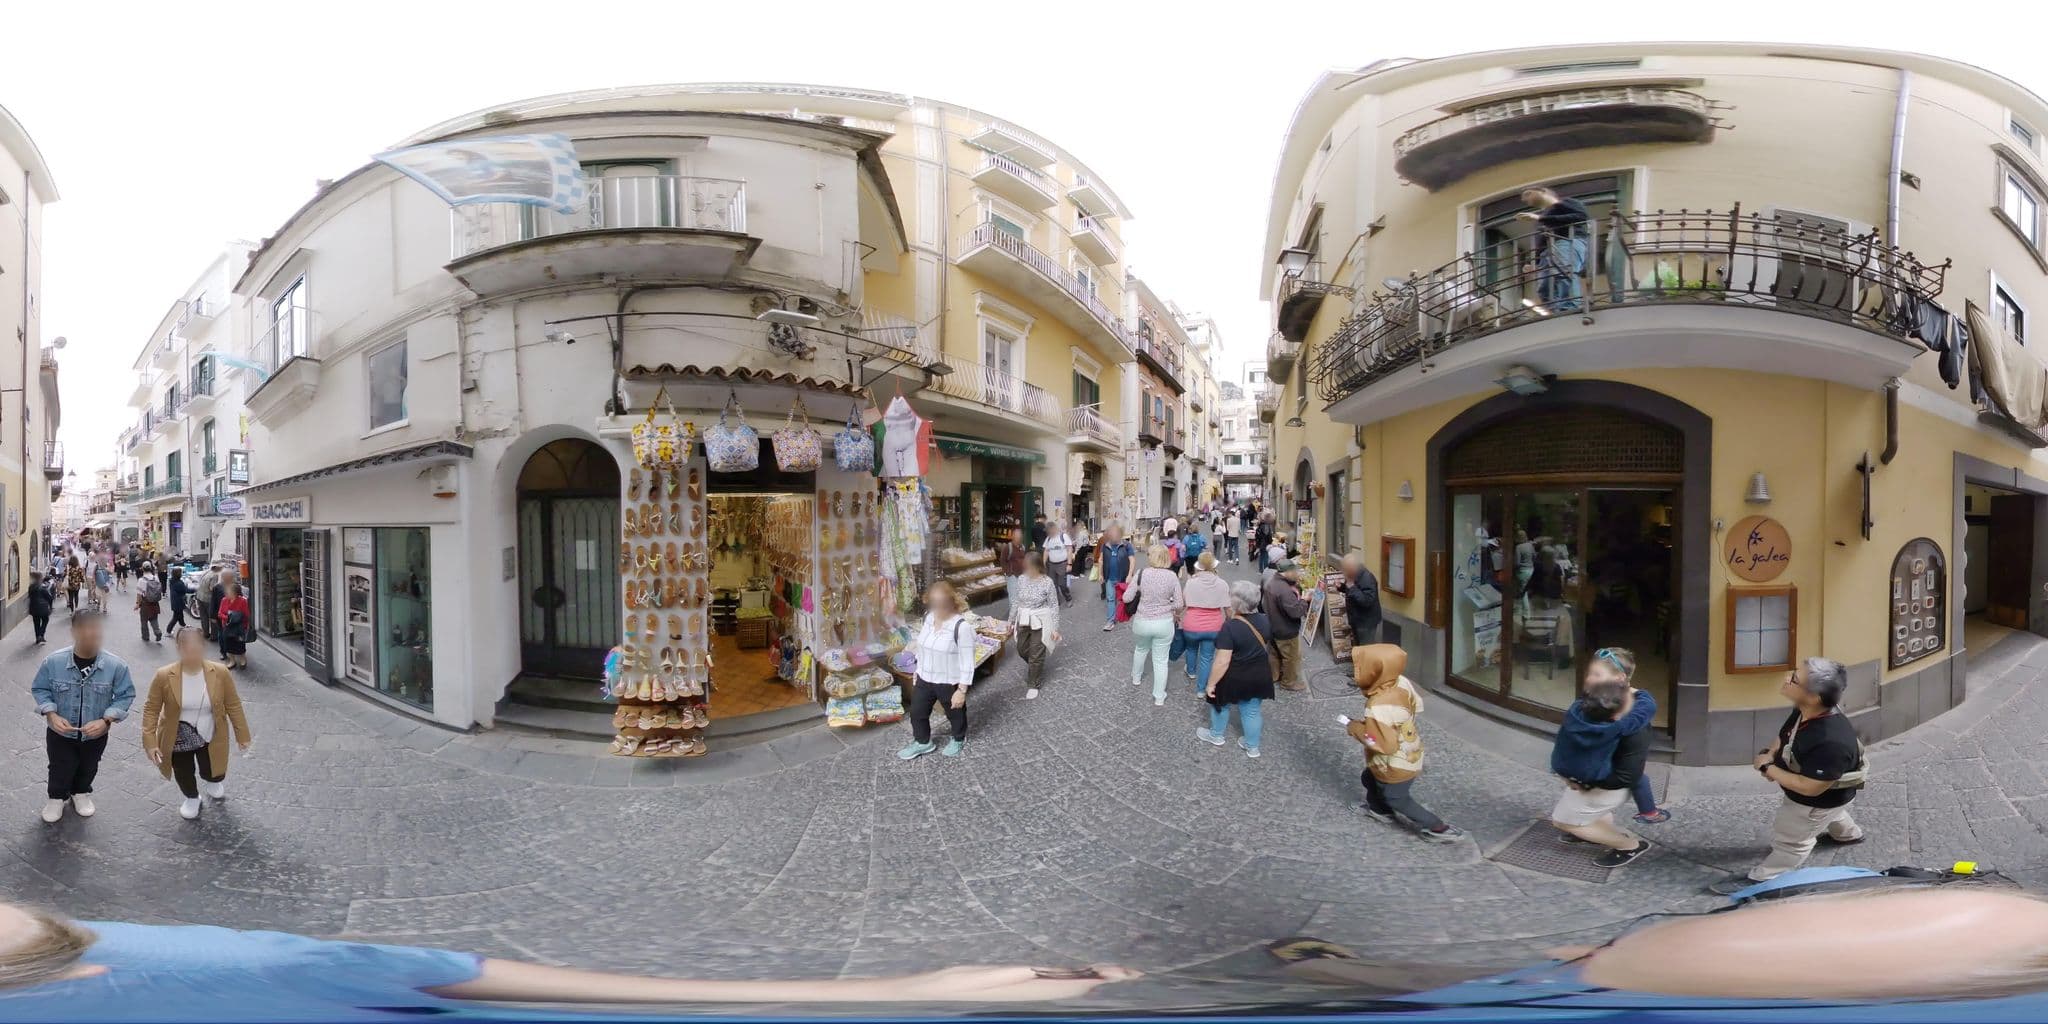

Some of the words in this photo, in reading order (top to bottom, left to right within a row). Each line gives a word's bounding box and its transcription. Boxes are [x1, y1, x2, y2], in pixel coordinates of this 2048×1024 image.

[234, 453, 245, 470] T
[252, 501, 303, 519] TABACCHI
[1729, 548, 1745, 564] la
[1748, 546, 1789, 571] galea
